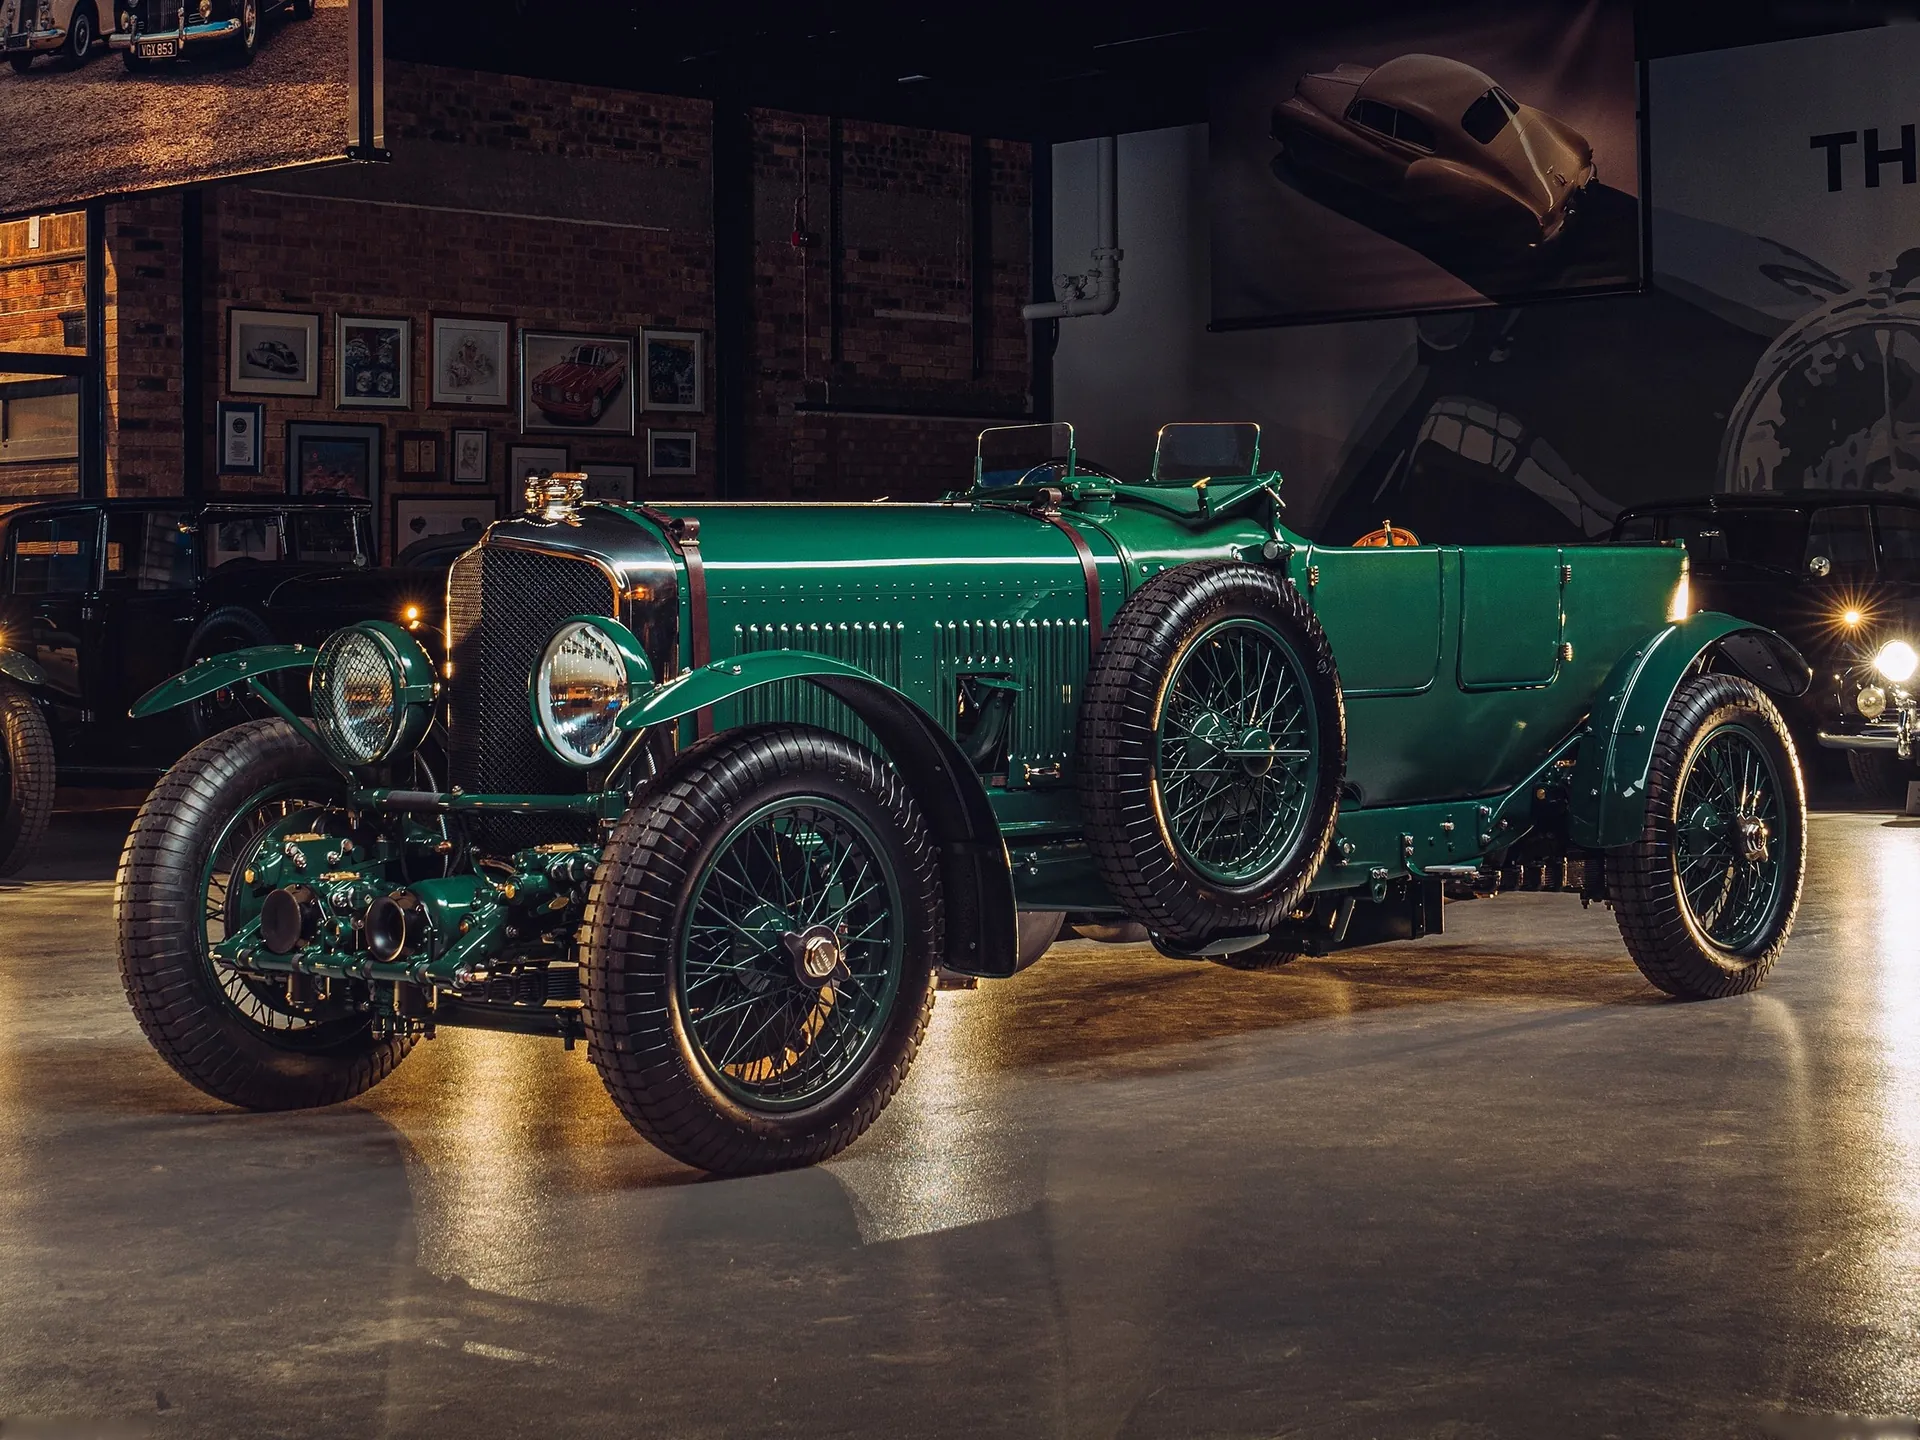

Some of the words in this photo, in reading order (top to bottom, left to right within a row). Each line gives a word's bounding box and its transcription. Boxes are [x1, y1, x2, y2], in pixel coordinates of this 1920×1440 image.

[141, 44, 156, 56] VGX
[157, 42, 173, 55] 853
[1810, 124, 1917, 192] TH
